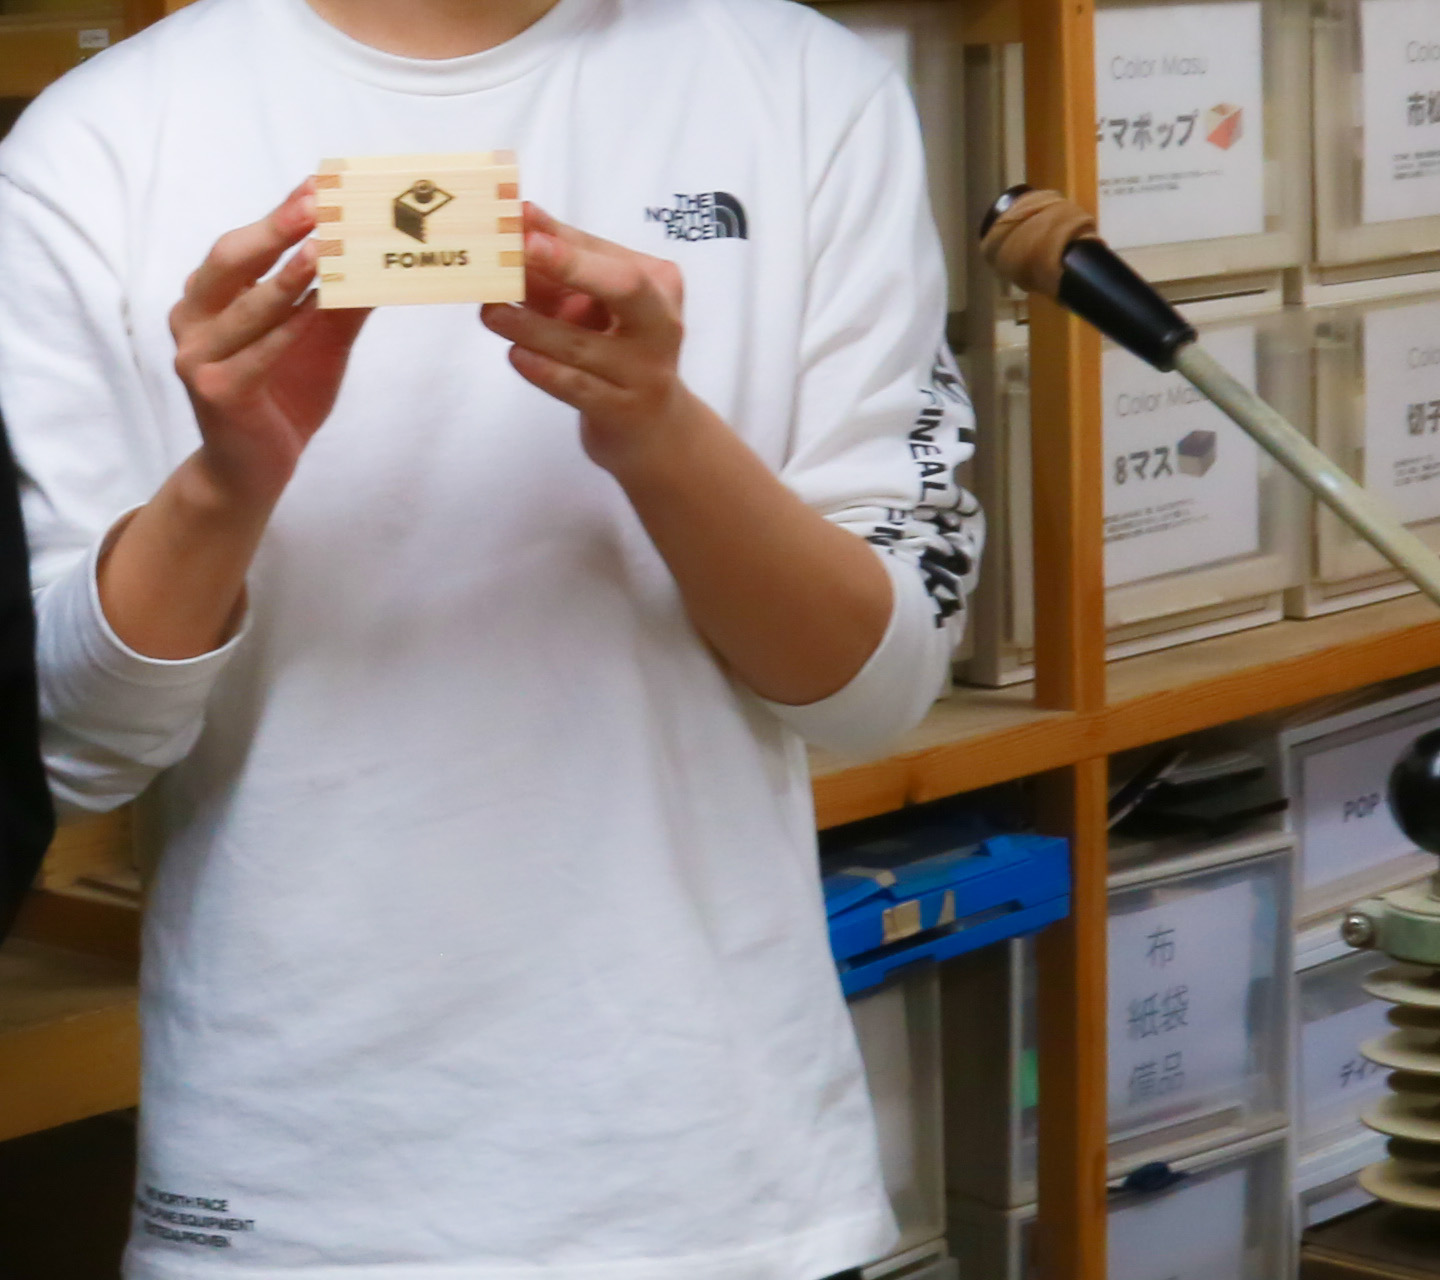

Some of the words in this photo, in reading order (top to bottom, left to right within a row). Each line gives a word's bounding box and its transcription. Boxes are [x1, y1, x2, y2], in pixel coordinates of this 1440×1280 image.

[1111, 55, 1157, 81] Color
[1162, 54, 1209, 77] Masu
[673, 191, 714, 208] THE
[644, 206, 714, 223] NORTH
[666, 222, 714, 241] FACE
[383, 248, 470, 271] FOMUS
[1117, 391, 1160, 417] Color
[1343, 791, 1381, 823] POP
[1146, 926, 1177, 968] 布
[1128, 985, 1190, 1041] 紙袋
